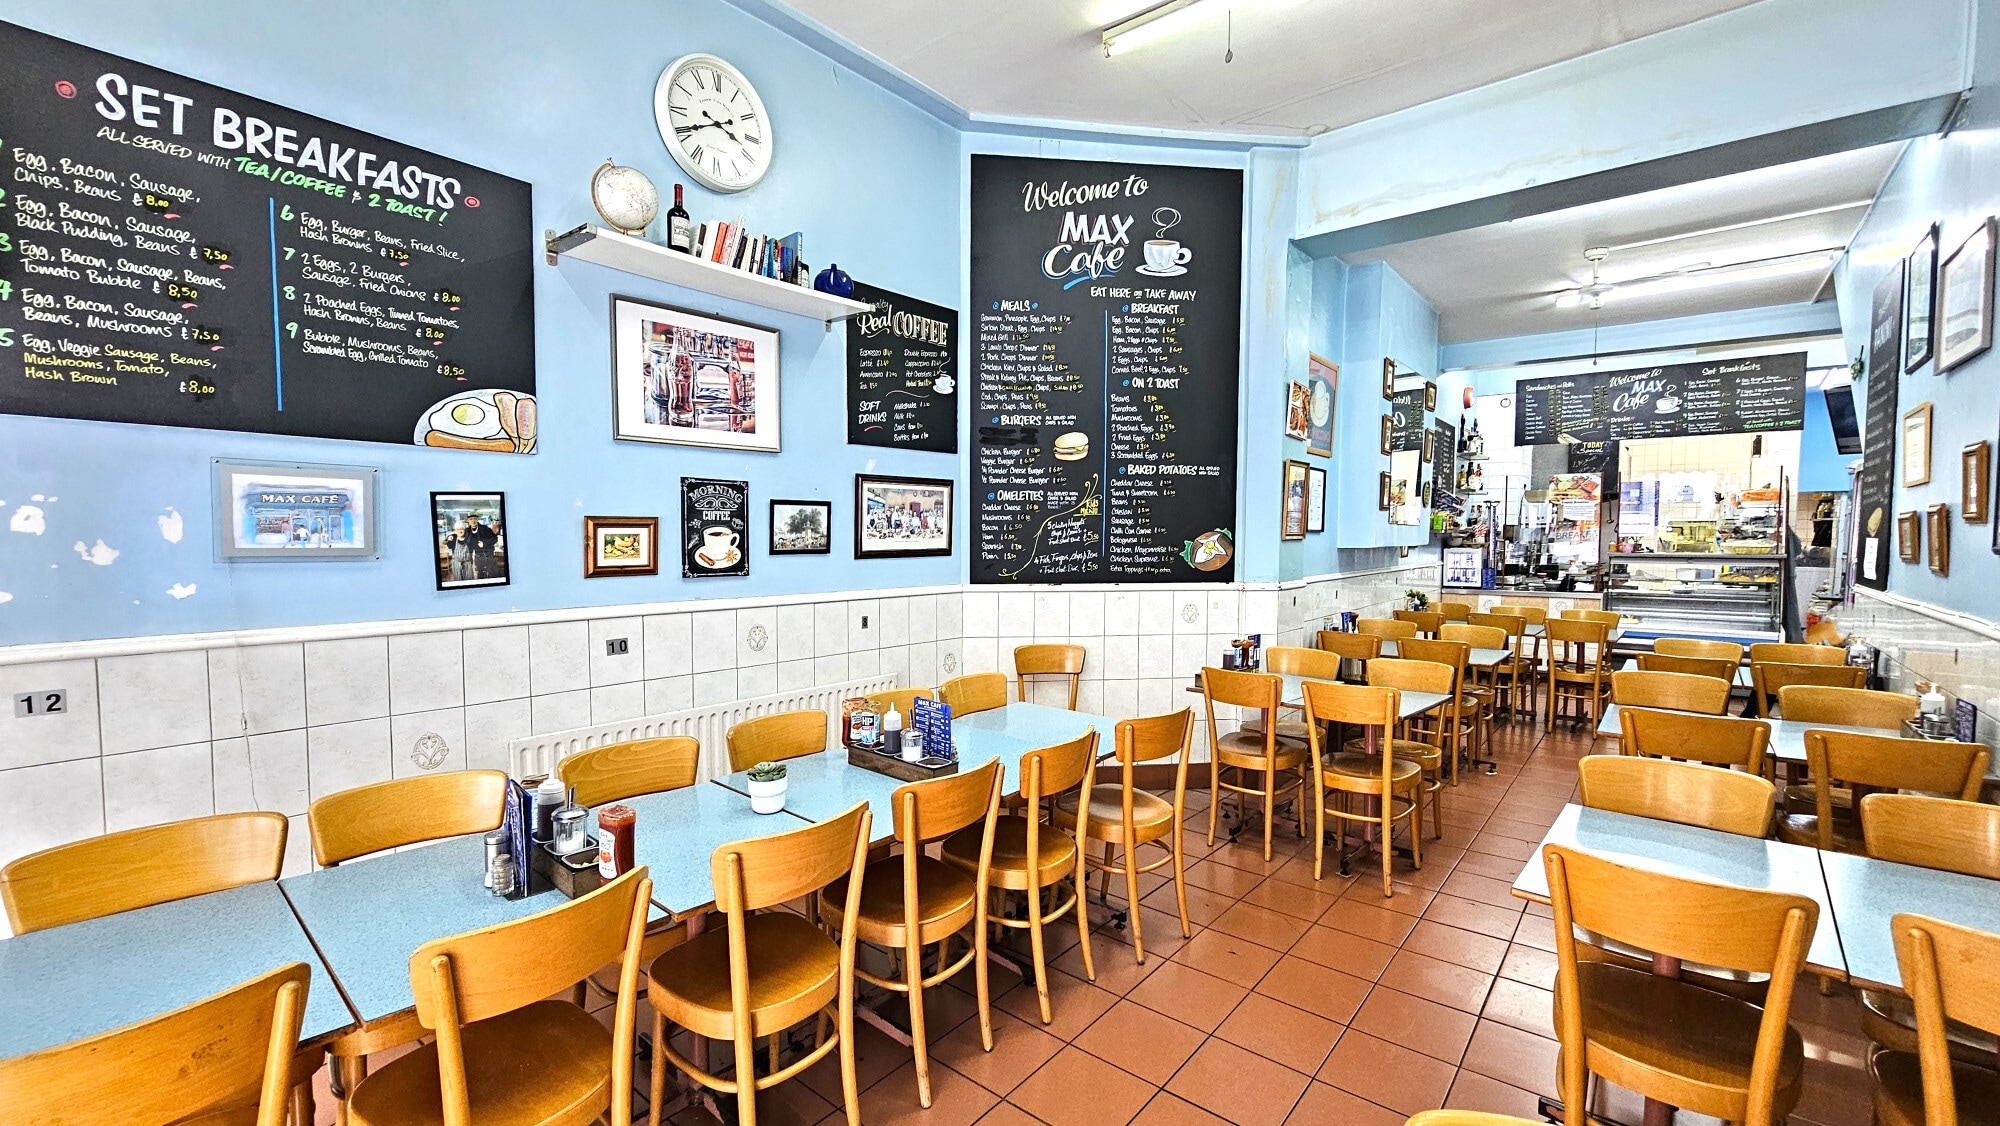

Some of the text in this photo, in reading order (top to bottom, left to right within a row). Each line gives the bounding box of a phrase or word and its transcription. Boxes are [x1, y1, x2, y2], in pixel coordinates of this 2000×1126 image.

[95, 72, 461, 210] SET BREAKFASTS
[97, 126, 130, 145] ALL
[132, 134, 193, 159] SERVED
[197, 151, 232, 170] WITH
[368, 193, 382, 208] 2
[74, 180, 121, 201] Beans
[1021, 174, 1150, 213] Welcome to
[15, 213, 60, 233] Black
[135, 235, 180, 255] Beans
[280, 204, 295, 221] 6
[410, 239, 435, 254] Fried
[1058, 211, 1135, 246] MAX
[299, 226, 329, 242] Hash
[331, 233, 373, 253] Browns
[283, 247, 296, 260] 7
[300, 252, 310, 265] 2
[349, 262, 359, 275] 2
[1042, 241, 1125, 279] Cafe
[20, 259, 80, 280] Tomato
[86, 270, 142, 289] Bubble
[0, 280, 13, 300] 4
[358, 279, 386, 293] Fried
[390, 285, 427, 301] Onions
[1090, 286, 1107, 298] EAT
[1109, 287, 1131, 298] HERE
[1144, 288, 1167, 299] TAKE
[1168, 289, 1197, 301] AWAY
[283, 285, 296, 301] 8
[303, 292, 312, 304] 2
[315, 294, 357, 312] Poached
[388, 307, 415, 321] Tinned
[1001, 300, 1030, 311] MEALS
[1131, 303, 1179, 314] BREAKFAST
[87, 315, 173, 338] Mushrooms
[303, 304, 331, 320] Hash
[376, 317, 407, 331] Beans
[857, 304, 892, 335] Real
[893, 311, 948, 347] COFFEE
[285, 321, 299, 339] 9
[0, 328, 15, 347] 5
[58, 339, 100, 357] Veggie
[302, 342, 346, 358] Scrambled
[368, 351, 397, 365] Grilled
[398, 356, 429, 368] Tomato
[25, 366, 65, 381] Hash
[70, 371, 118, 386] Brown
[1610, 368, 1662, 388] Welcome to
[1702, 368, 1717, 376] Set
[1132, 377, 1180, 389] ON 2 TOAST
[1631, 379, 1667, 394] MAX
[859, 401, 881, 411] SOFT
[1613, 391, 1650, 412] Cafe
[859, 412, 887, 424] DRINKS
[1001, 415, 1041, 426] BURGERS
[1582, 441, 1604, 449] TODAY
[1128, 464, 1156, 475] BAKED
[1159, 465, 1197, 476] POTATOES
[261, 494, 295, 503] MAX
[688, 485, 743, 503] MORNING
[997, 490, 1043, 501] OMELETTES
[703, 511, 730, 520] COFFEE
[609, 640, 628, 654] 10
[21, 693, 62, 714] 12
[862, 716, 873, 725] HP
